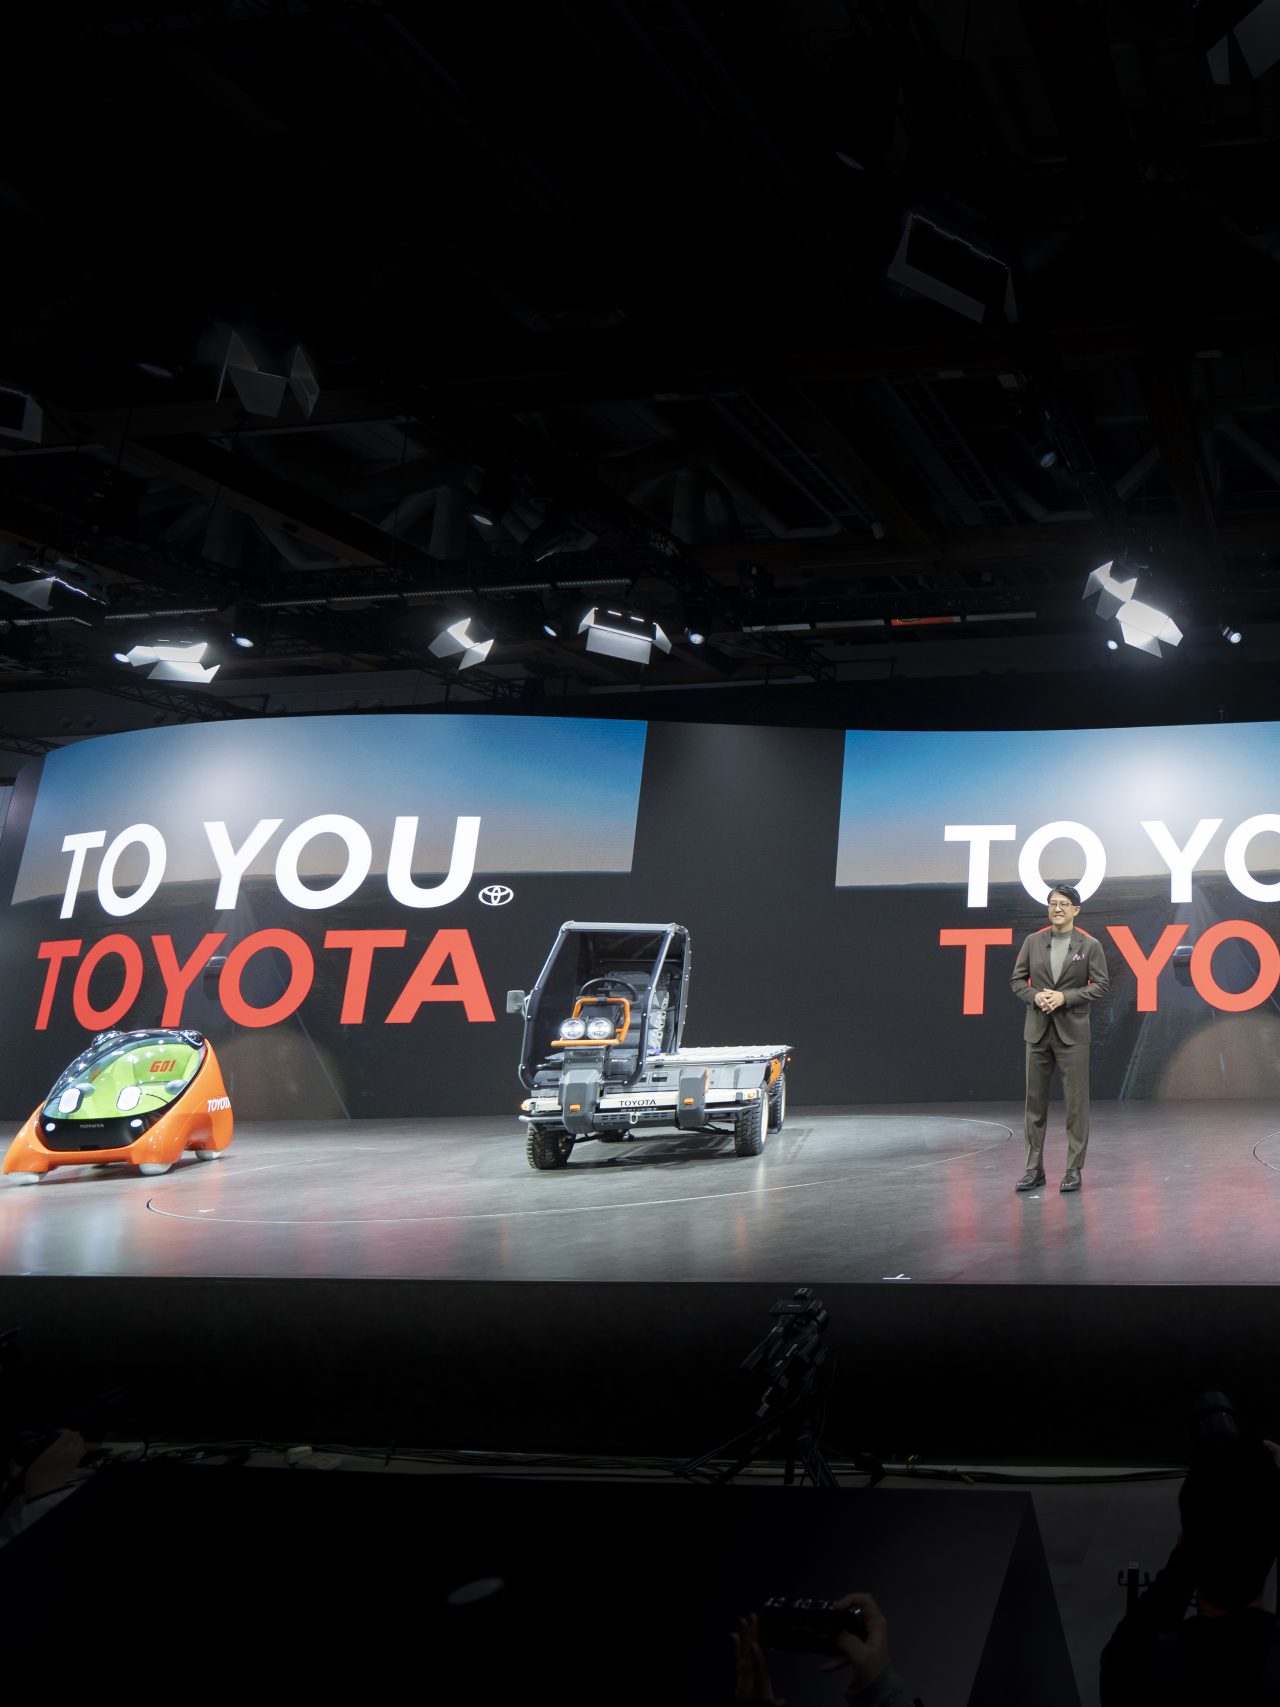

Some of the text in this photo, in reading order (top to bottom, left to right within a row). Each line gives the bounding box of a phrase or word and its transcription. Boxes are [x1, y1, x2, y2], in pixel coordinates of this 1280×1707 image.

[60, 814, 480, 919] TO YOU
[944, 820, 1107, 908] TO
[35, 928, 496, 1030] TOYOTA
[149, 1060, 176, 1073] GO!
[619, 1099, 657, 1107] TOYOTA
